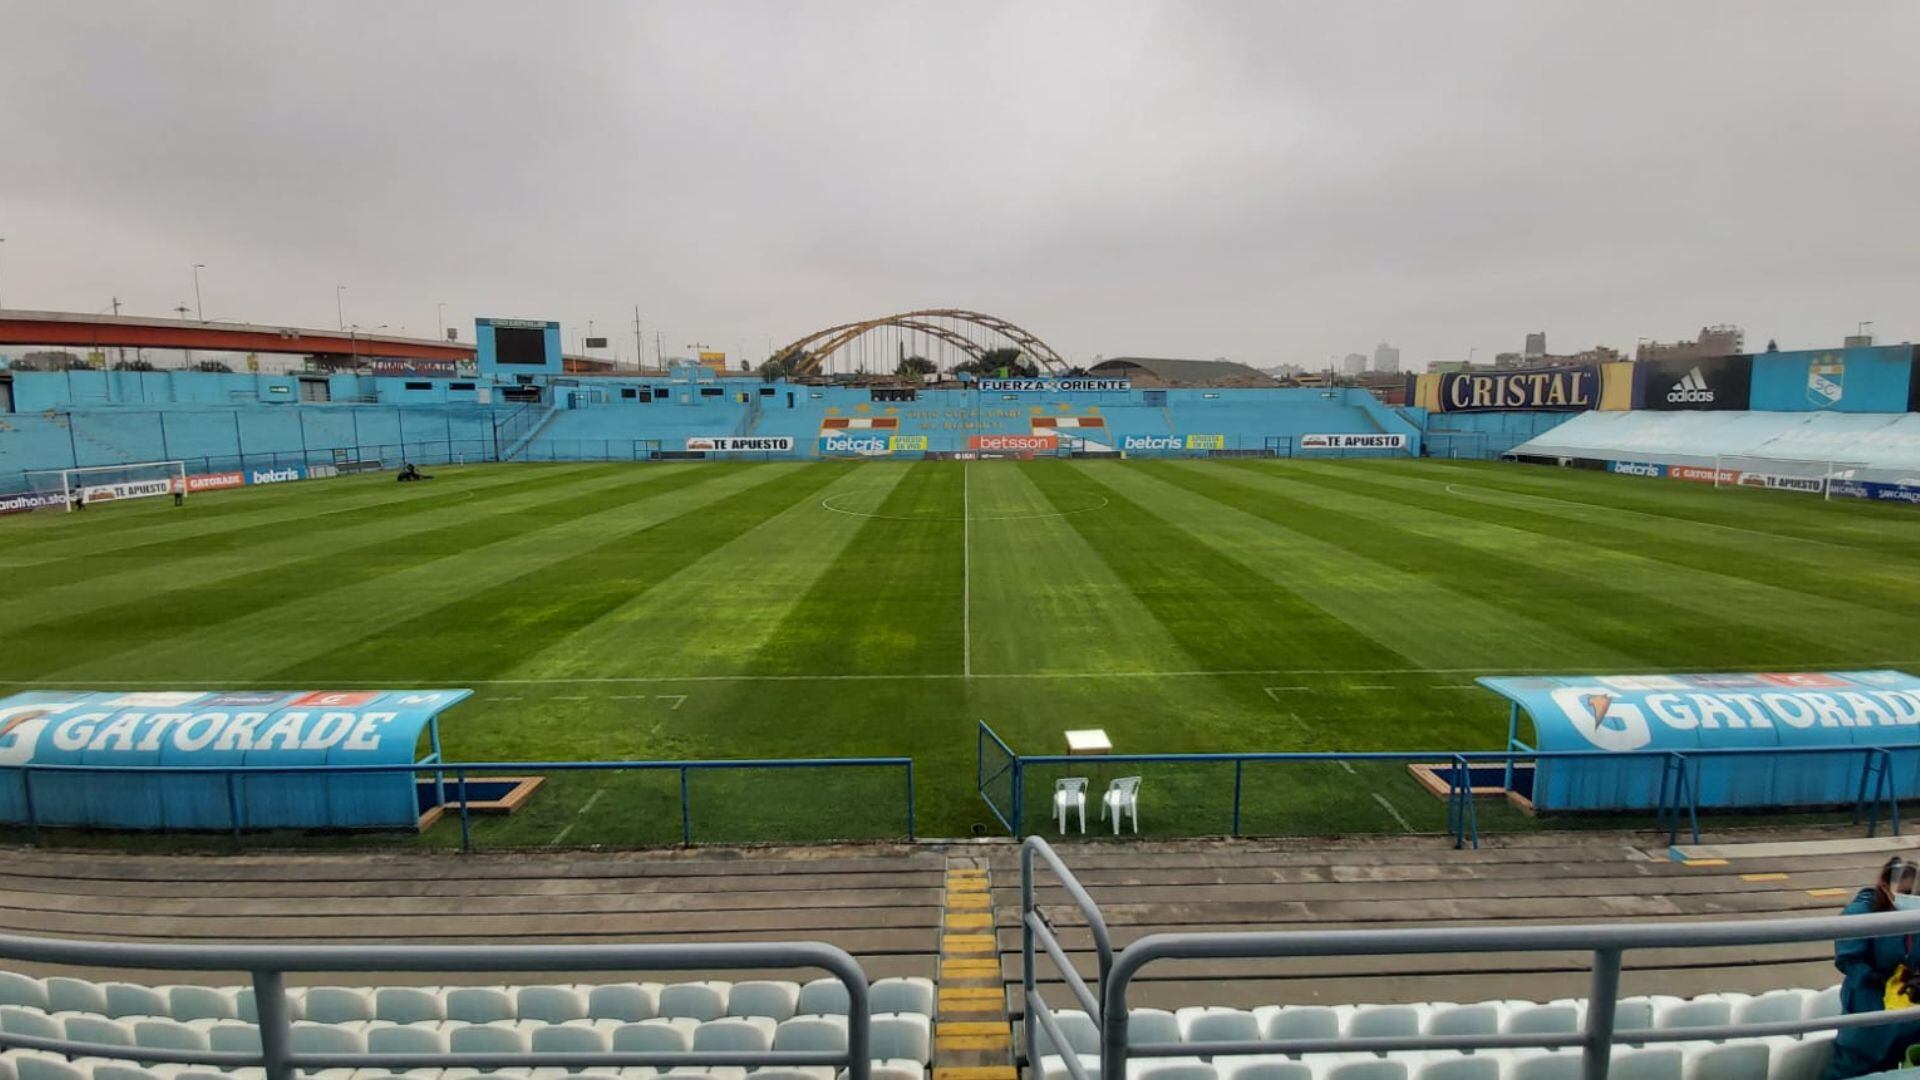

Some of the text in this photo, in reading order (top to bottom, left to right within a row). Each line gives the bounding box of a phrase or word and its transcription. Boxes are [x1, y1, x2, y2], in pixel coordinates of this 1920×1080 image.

[982, 381, 1129, 390] FUERZA ORIENTE
[1451, 372, 1587, 408] CRISTAL
[1667, 390, 1714, 402] adidas
[715, 439, 788, 450] TE APUESTO
[827, 437, 885, 450] betcris
[980, 437, 1049, 449] betsson
[1124, 436, 1182, 449] betcris
[1328, 436, 1399, 446] TE APUESTO
[1614, 460, 1660, 477] betcris
[254, 468, 299, 484] betcris
[1767, 476, 1820, 490] TE APUESTO
[115, 483, 167, 498] TE APUESTO
[53, 713, 397, 750] GATORADE
